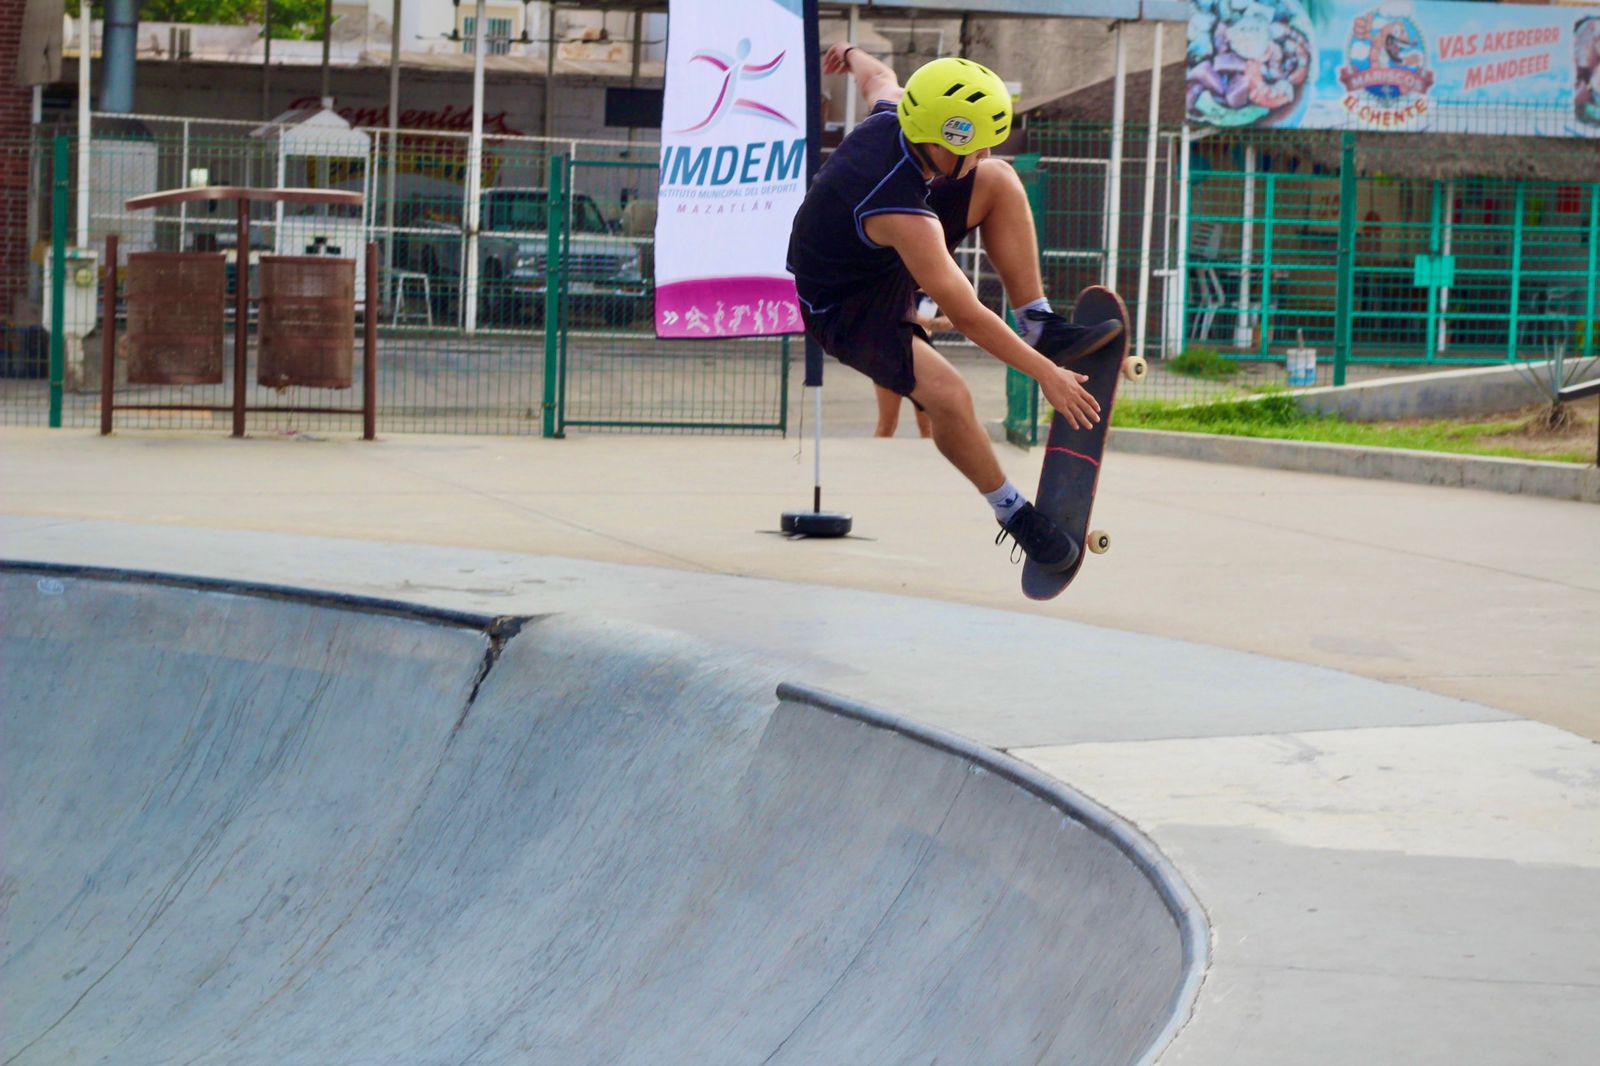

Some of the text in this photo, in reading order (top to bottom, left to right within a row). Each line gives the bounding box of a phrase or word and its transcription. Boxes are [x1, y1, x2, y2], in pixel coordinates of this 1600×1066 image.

[1438, 33, 1479, 60] VAS
[1359, 99, 1428, 128] CHENTE
[660, 138, 808, 186] IMDEM
[698, 187, 742, 199] MUNICIPAL
[744, 186, 759, 197] DEL
[761, 183, 797, 195] DEPORTE
